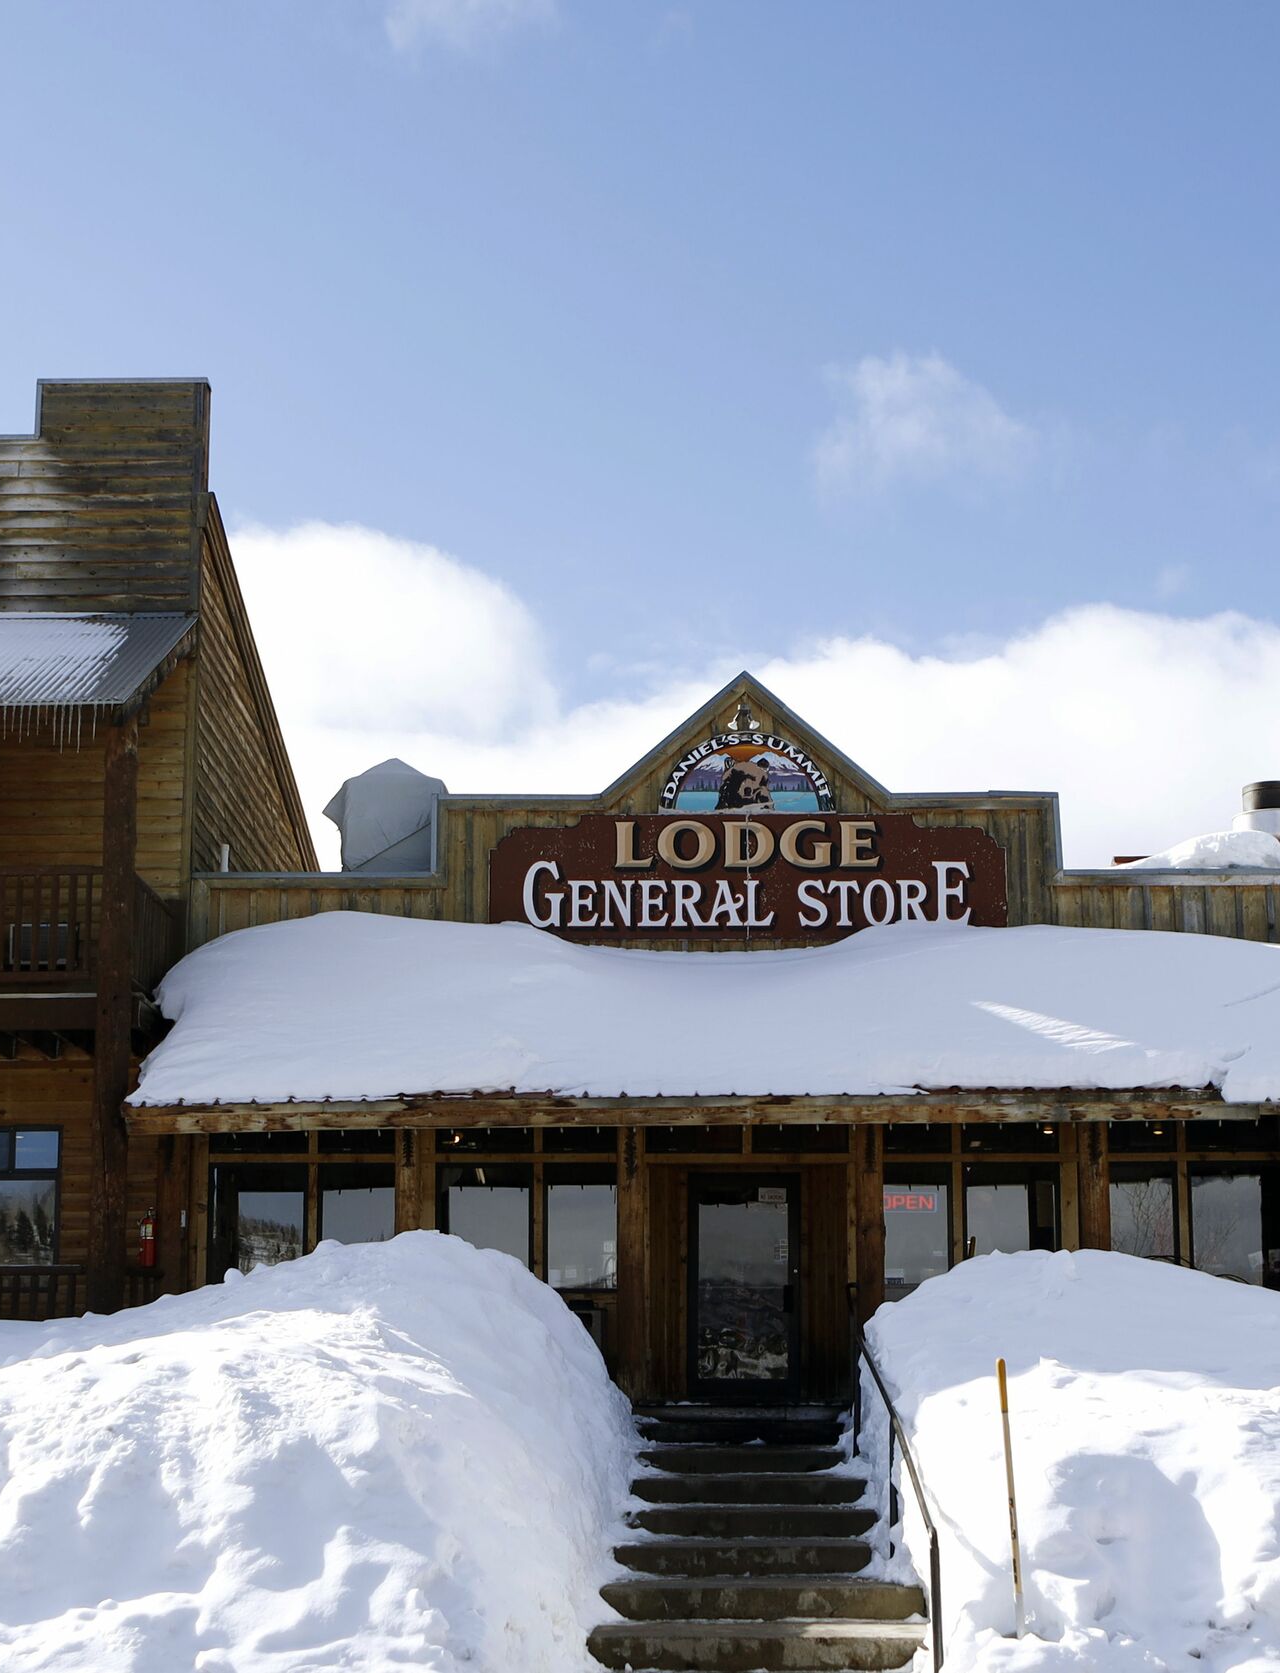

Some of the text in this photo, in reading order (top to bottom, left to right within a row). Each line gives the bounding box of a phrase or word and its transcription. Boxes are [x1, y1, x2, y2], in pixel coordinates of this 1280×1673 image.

[752, 733, 832, 800] SUMMIT
[614, 820, 881, 868] LODGE
[522, 861, 972, 928] GENERAL STORE
